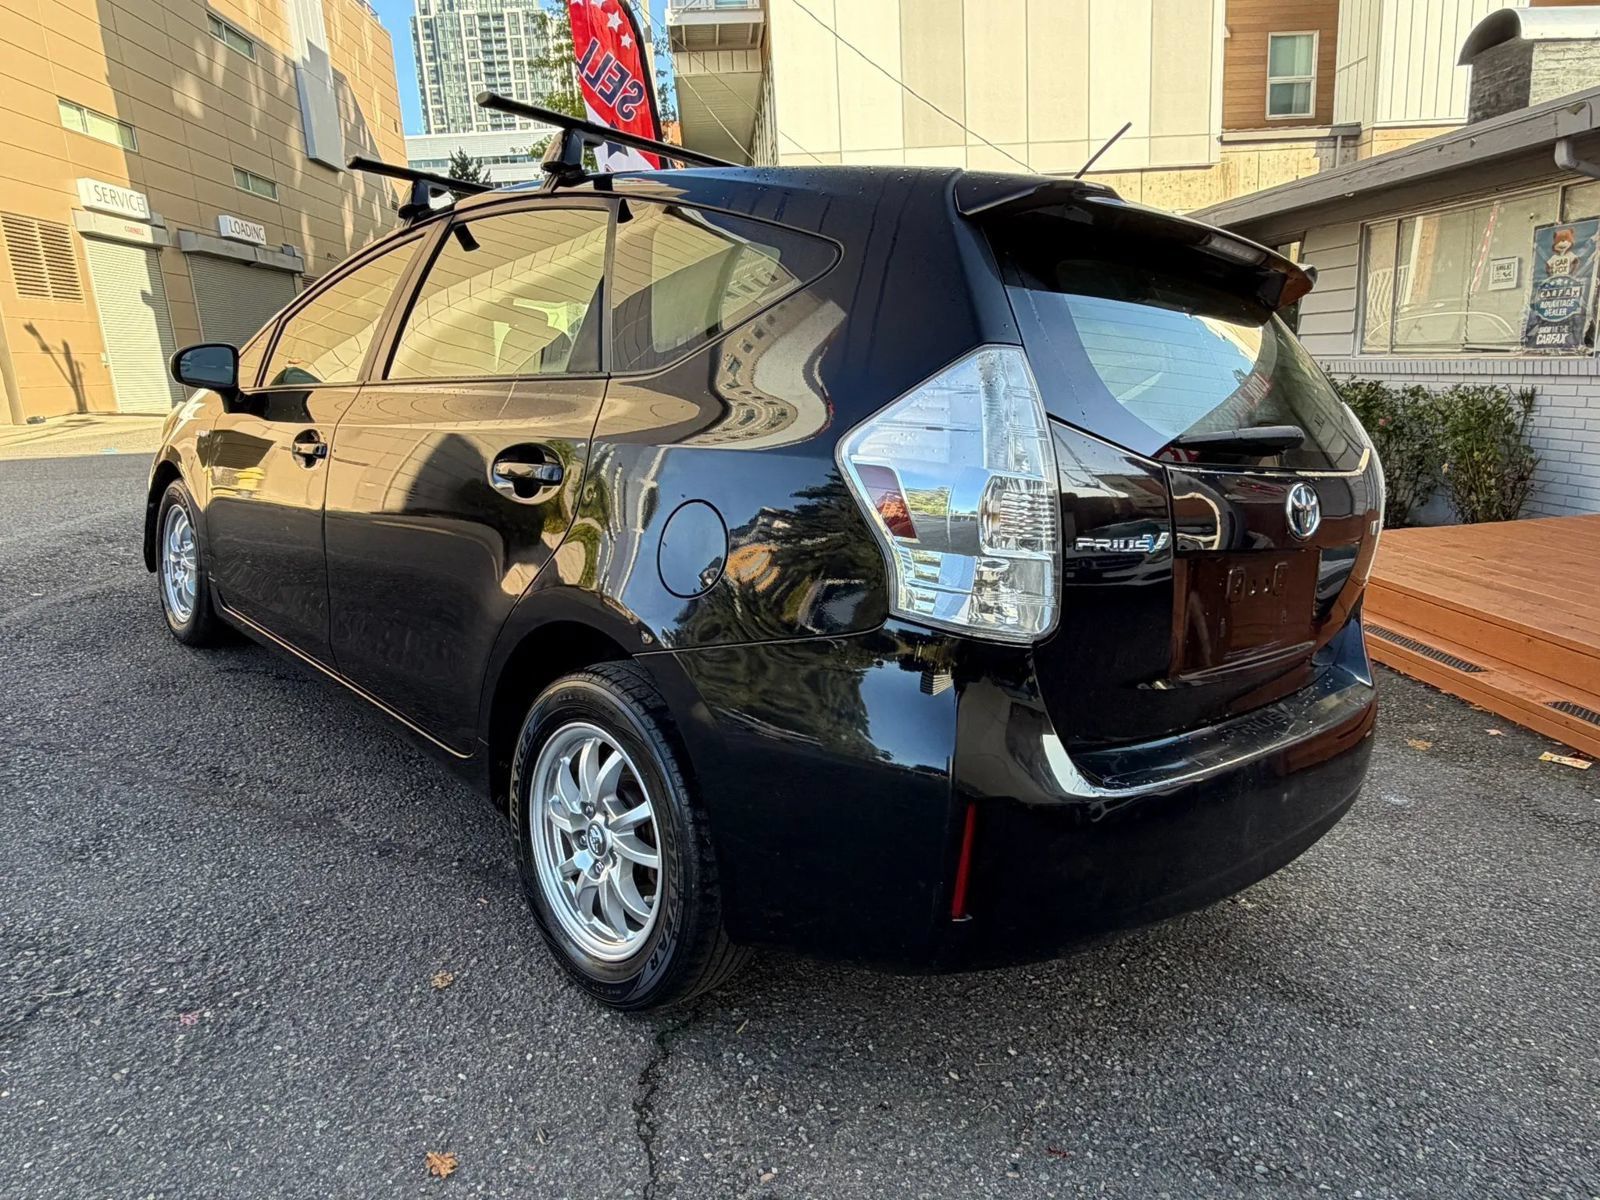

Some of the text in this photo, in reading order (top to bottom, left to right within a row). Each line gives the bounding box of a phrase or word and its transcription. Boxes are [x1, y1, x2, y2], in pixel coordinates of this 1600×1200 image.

[93, 184, 145, 213] SERVICE
[228, 218, 265, 241] LOADING
[1540, 286, 1580, 299] CARFAX
[1544, 308, 1568, 317] DEALER
[1536, 333, 1569, 345] CARFAX
